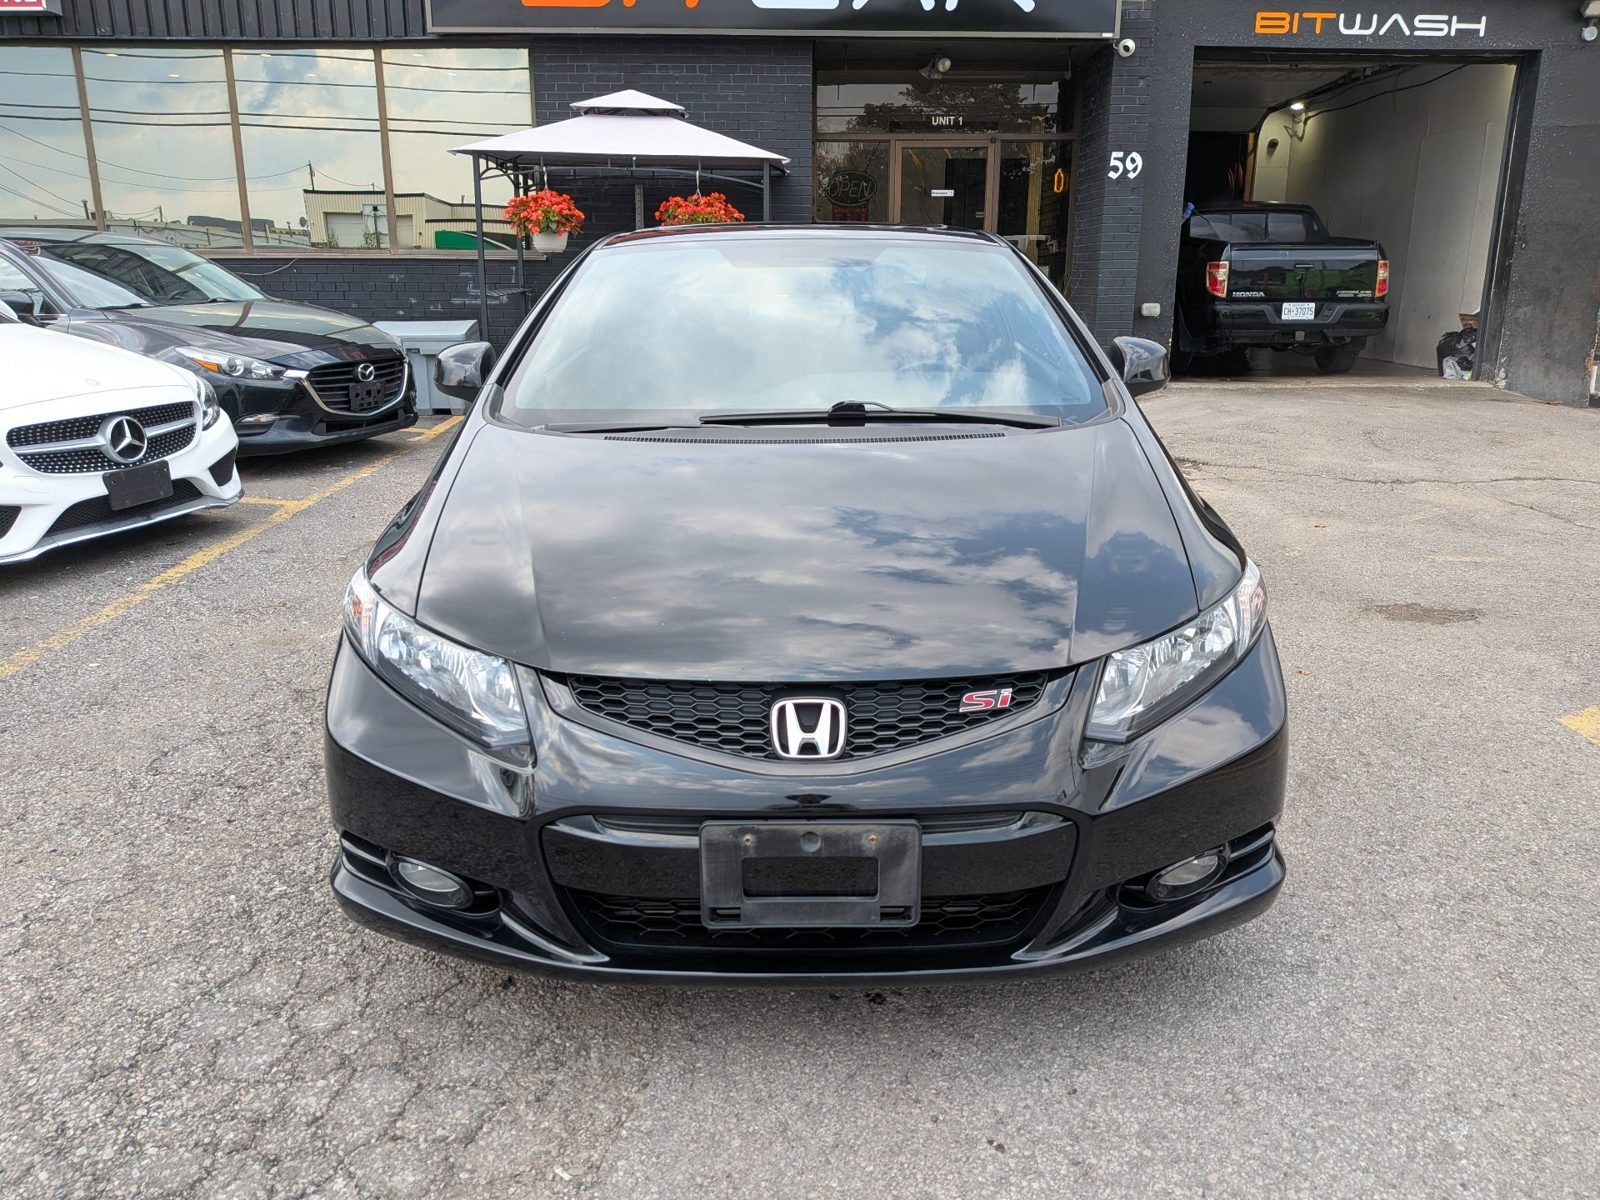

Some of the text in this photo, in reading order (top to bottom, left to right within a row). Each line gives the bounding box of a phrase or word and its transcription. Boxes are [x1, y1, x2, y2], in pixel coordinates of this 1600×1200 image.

[1255, 11, 1487, 37] BITWASH
[932, 116, 963, 125] UNIT 1
[1107, 151, 1143, 179] 59
[828, 180, 872, 197] OPEN
[959, 688, 1013, 712] Si
